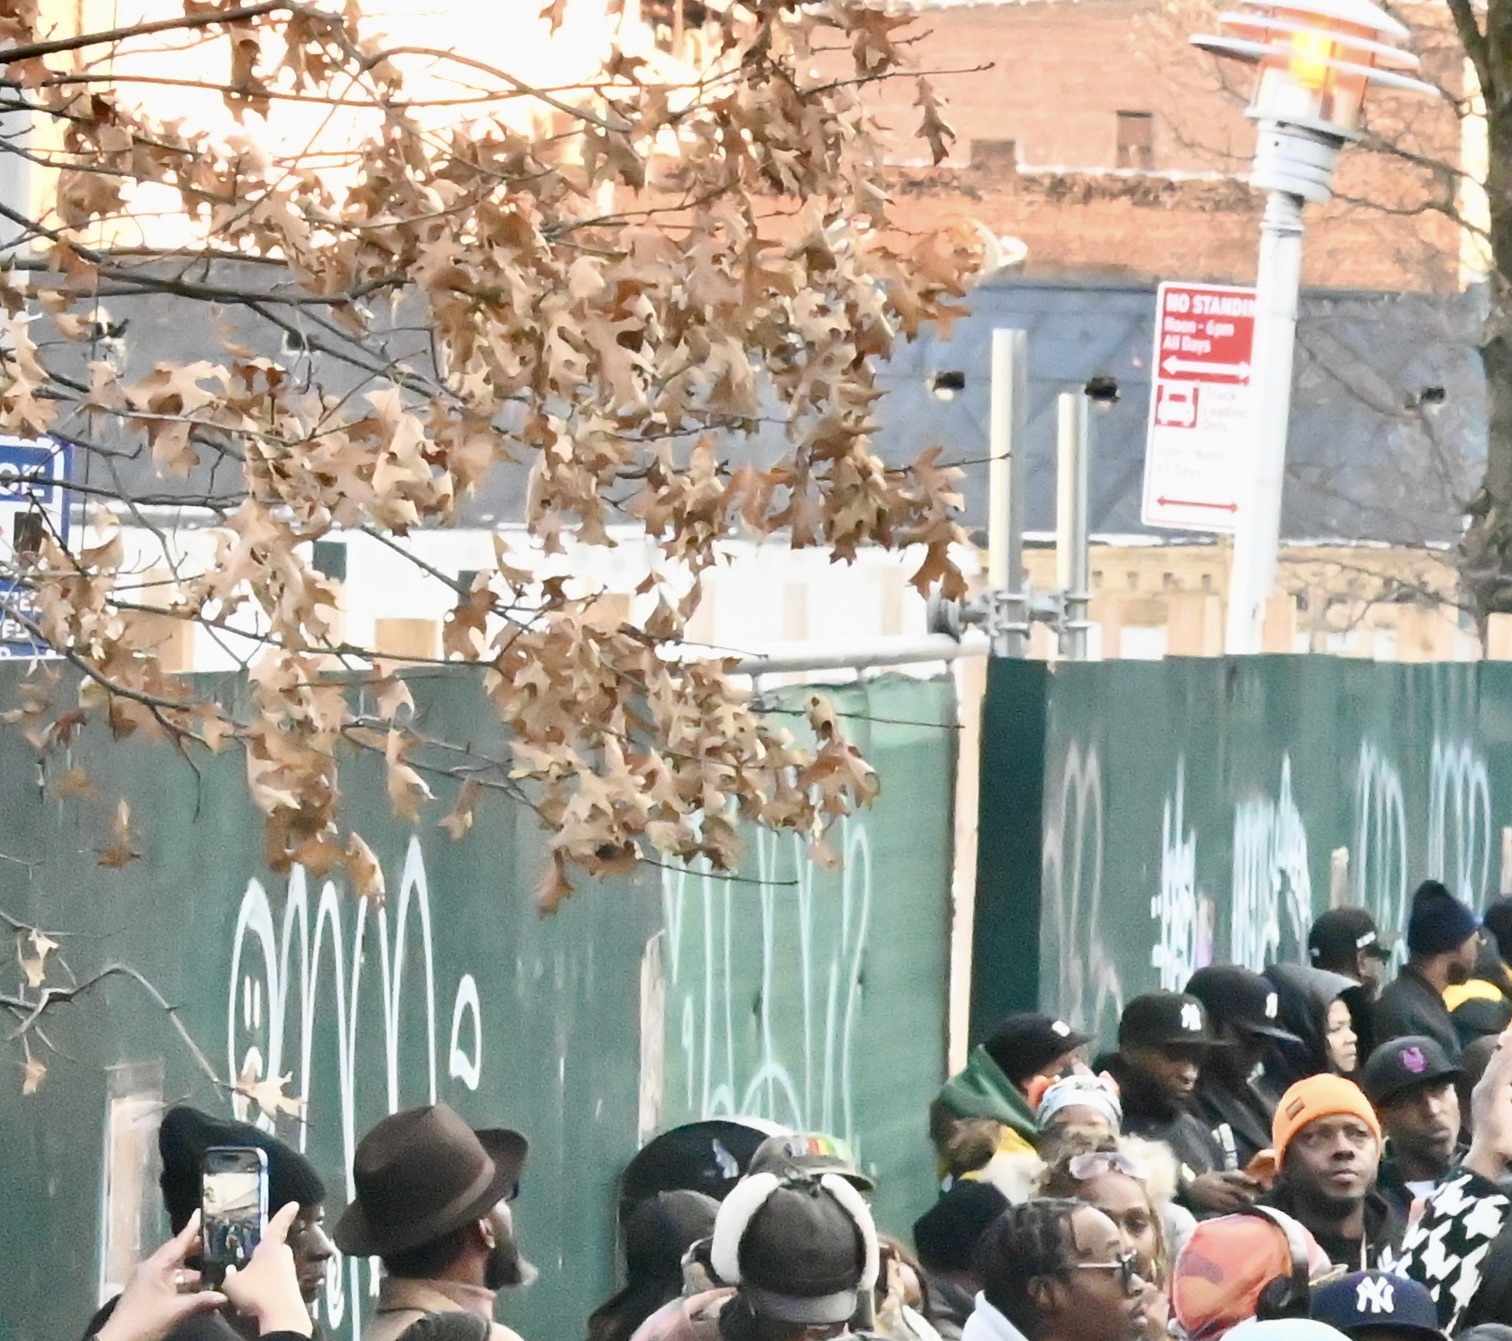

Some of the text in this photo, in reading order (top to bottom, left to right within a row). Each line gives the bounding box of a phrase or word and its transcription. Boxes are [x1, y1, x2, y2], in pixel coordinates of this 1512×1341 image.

[1166, 292, 1257, 318] NO STANDIN
[1356, 1276, 1395, 1313] NY
